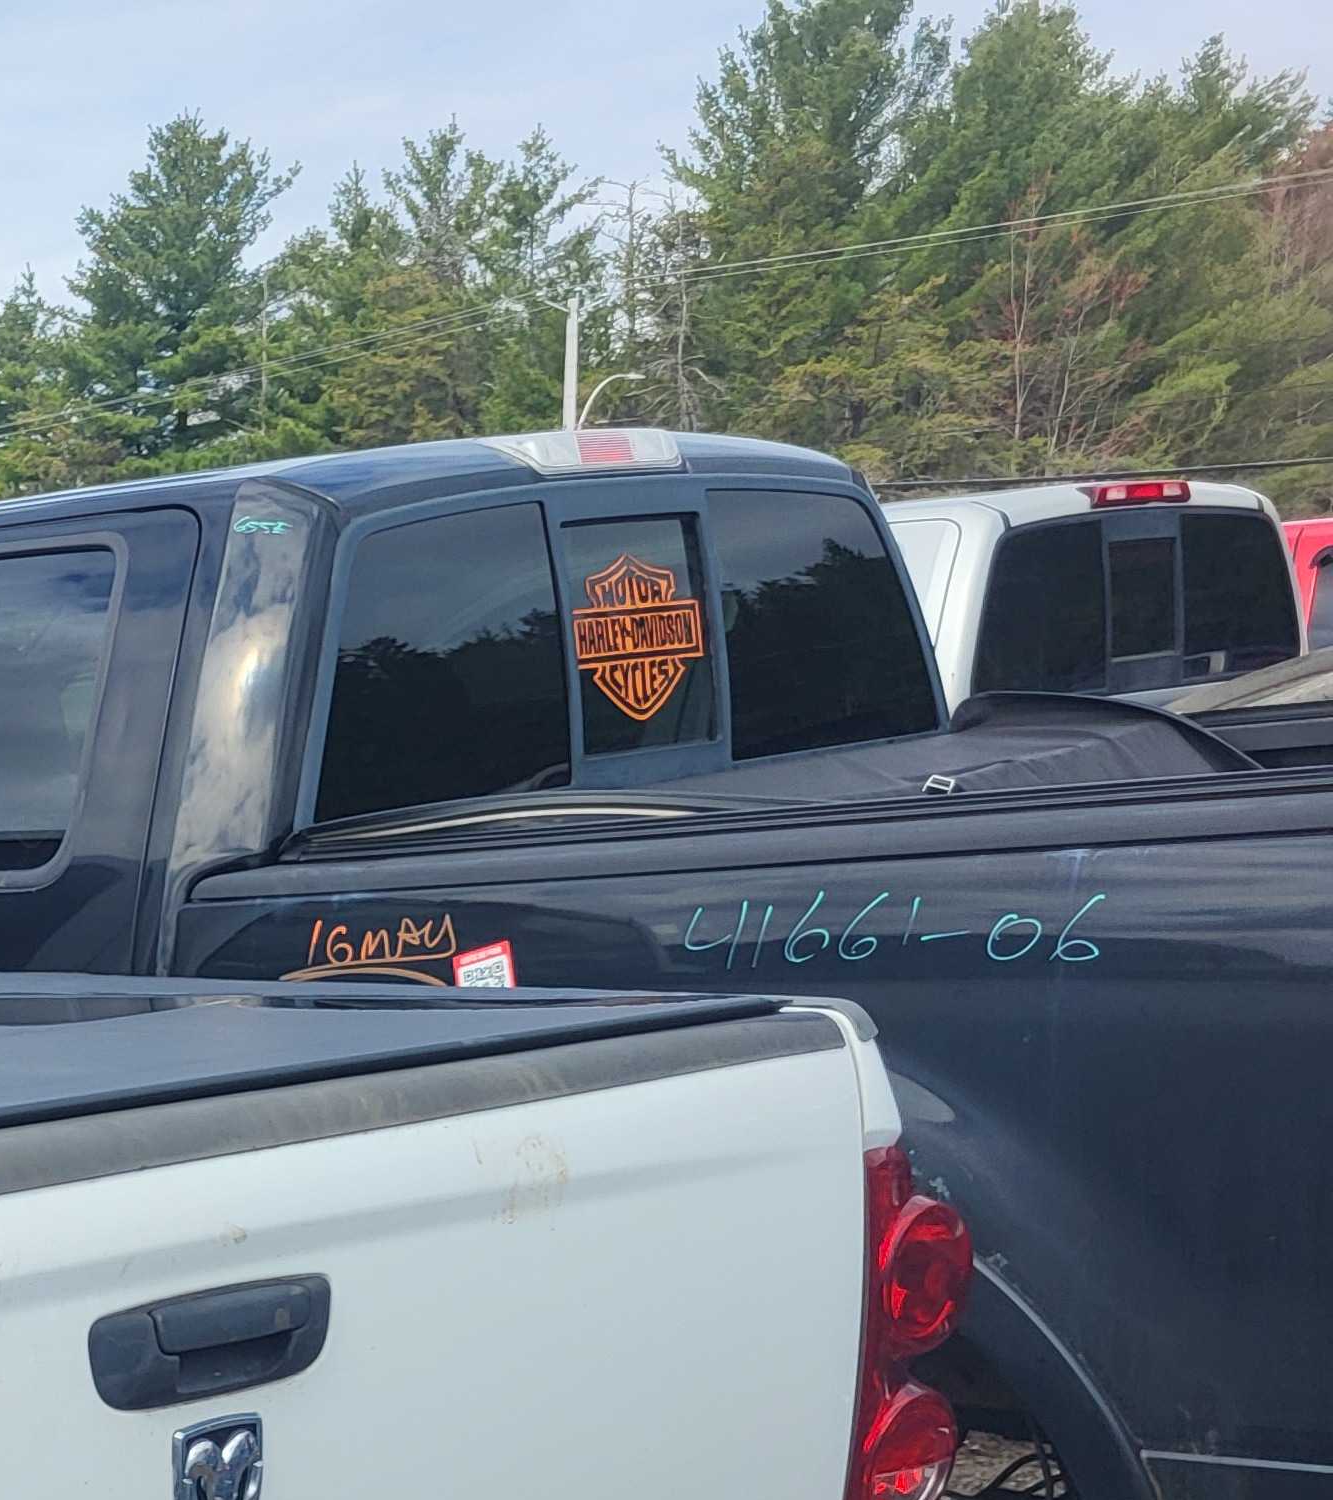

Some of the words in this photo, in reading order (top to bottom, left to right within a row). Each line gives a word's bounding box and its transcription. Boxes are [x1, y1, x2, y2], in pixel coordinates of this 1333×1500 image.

[576, 610, 695, 656] HARLEY-DAVIDSON
[608, 659, 672, 707] CYCLES
[684, 890, 1108, 970] 41661-06
